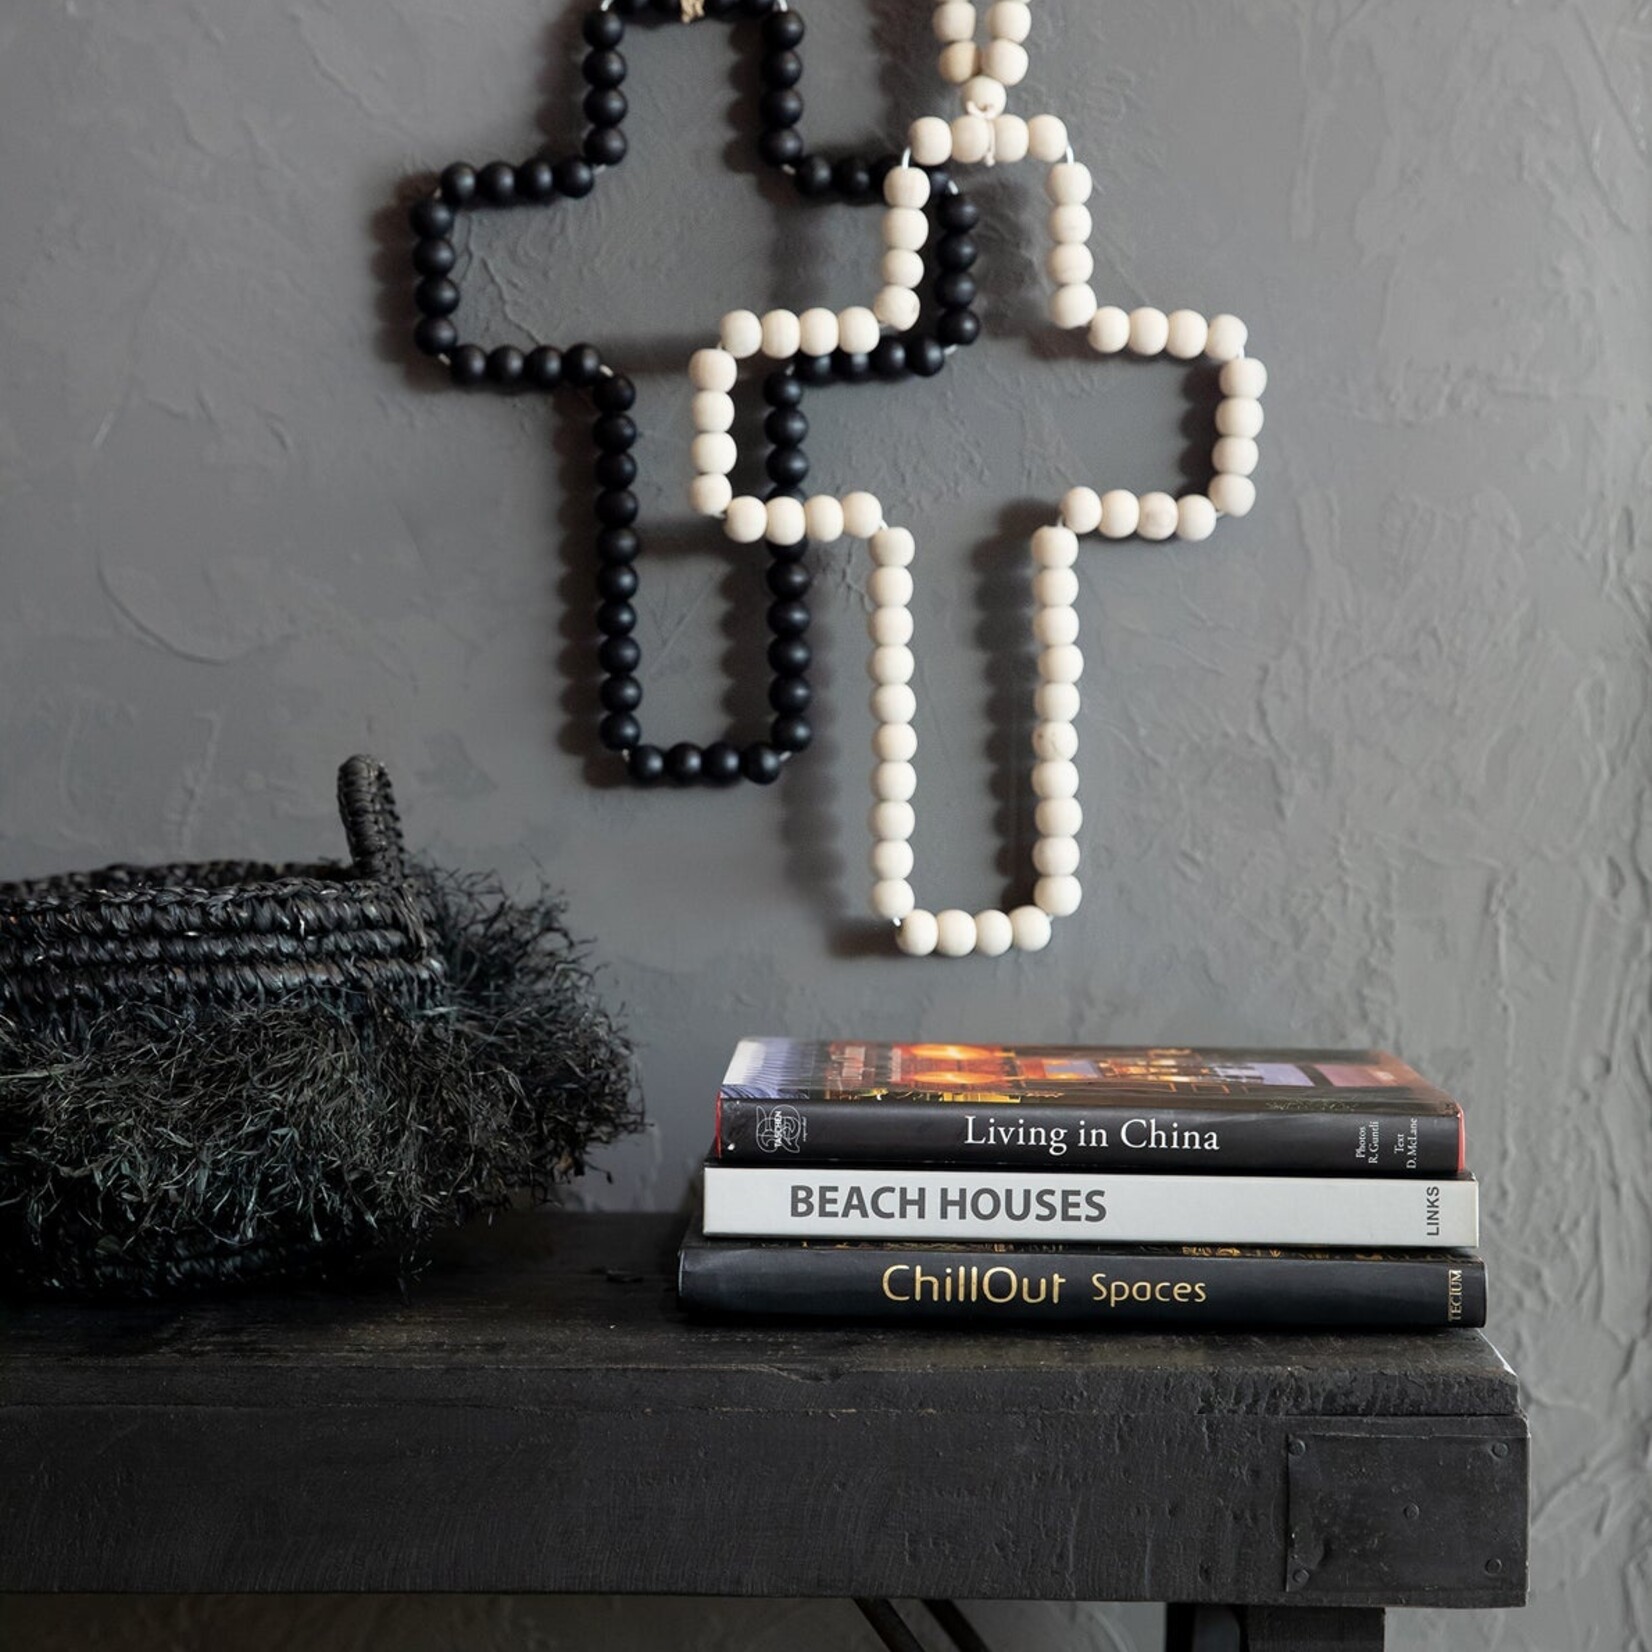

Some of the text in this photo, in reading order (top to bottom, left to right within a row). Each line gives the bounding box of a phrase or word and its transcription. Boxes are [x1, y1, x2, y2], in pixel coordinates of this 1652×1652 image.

[964, 1115, 1220, 1156] Living in China
[1355, 1126, 1367, 1158] Photos
[1394, 1133, 1405, 1154] Text
[1406, 1117, 1418, 1169] D. McLane
[1368, 1153, 1379, 1164] R.
[790, 1185, 1107, 1222] BEACH HOUSES
[1426, 1186, 1440, 1236] LINKS
[882, 1264, 1207, 1308] ChillOut Spaces
